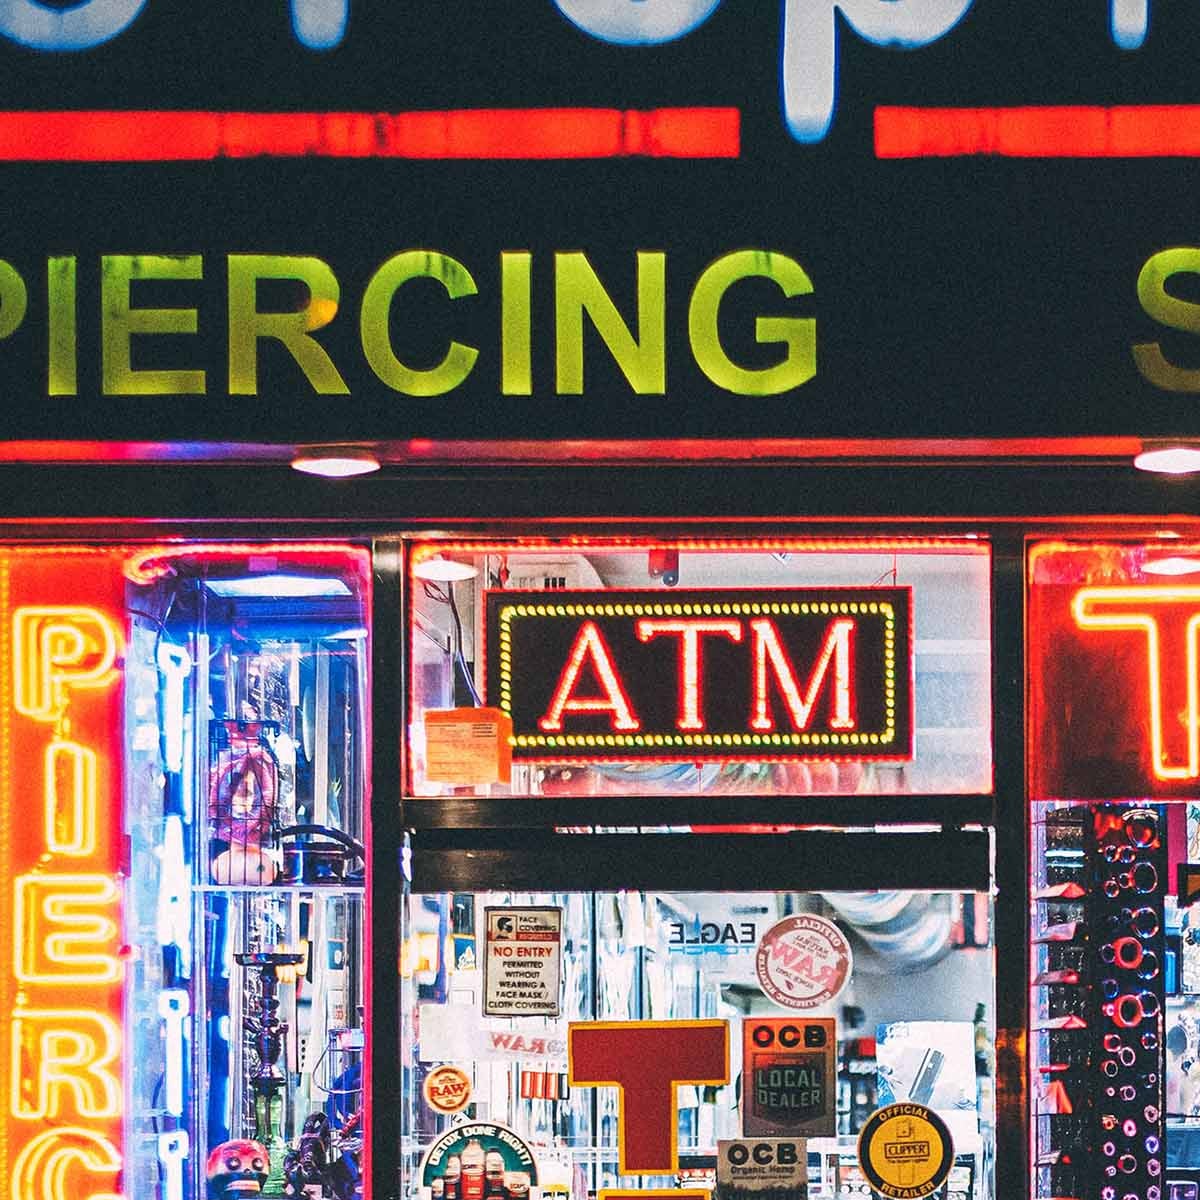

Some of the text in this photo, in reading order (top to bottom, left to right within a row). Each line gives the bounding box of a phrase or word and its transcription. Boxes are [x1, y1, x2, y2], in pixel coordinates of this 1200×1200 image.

[0, 250, 817, 396] IERCING
[541, 618, 856, 732] ATM
[493, 947, 553, 957] NO ENTRY
[515, 1001, 557, 1009] COVERING
[752, 1025, 827, 1048] OCB
[757, 1069, 821, 1088] LOCAL
[430, 1082, 465, 1097] RAW
[757, 1090, 821, 1107] DEALER
[879, 1105, 929, 1122] OFFICIAL
[428, 1131, 462, 1166] DETOX
[462, 1126, 497, 1137] DONE
[727, 1143, 799, 1165] OCB
[888, 1145, 926, 1156] CLIPPER
[881, 1183, 935, 1199] RETAILER
